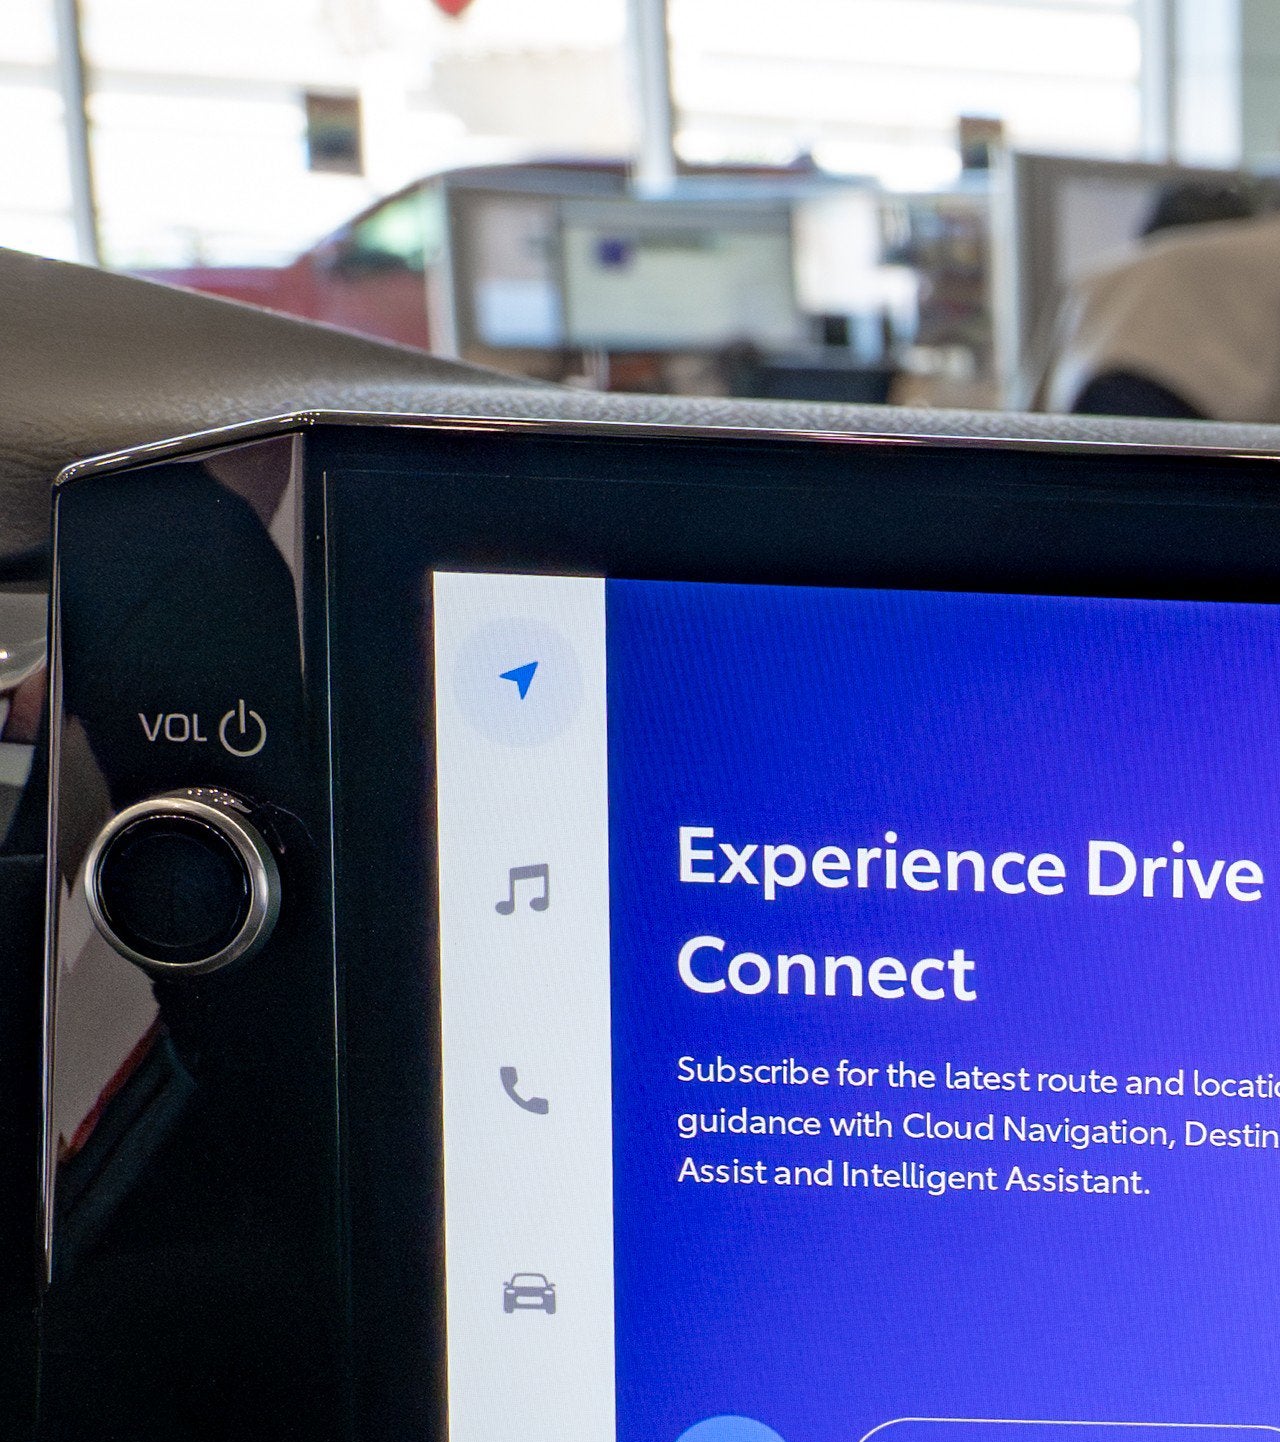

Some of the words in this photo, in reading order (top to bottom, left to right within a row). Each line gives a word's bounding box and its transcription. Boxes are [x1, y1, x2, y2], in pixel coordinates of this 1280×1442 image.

[138, 712, 208, 742] VOL
[679, 826, 1067, 901] Experience
[1088, 840, 1265, 902] Drive
[677, 935, 978, 1002] Connect
[677, 1055, 830, 1086] Subscribe
[835, 1059, 880, 1087] for
[886, 1060, 936, 1089] the
[945, 1062, 1031, 1092] latest
[1037, 1069, 1118, 1094] route
[1125, 1069, 1184, 1096] and
[677, 1106, 821, 1139] guidance
[829, 1110, 893, 1138] with
[902, 1111, 994, 1141] Cloud
[1004, 1115, 1176, 1150] Navigation,
[677, 1156, 768, 1185] Assist
[774, 1159, 833, 1187] and
[842, 1161, 999, 1196] Intelligent
[1004, 1165, 1150, 1195] Assistant.
